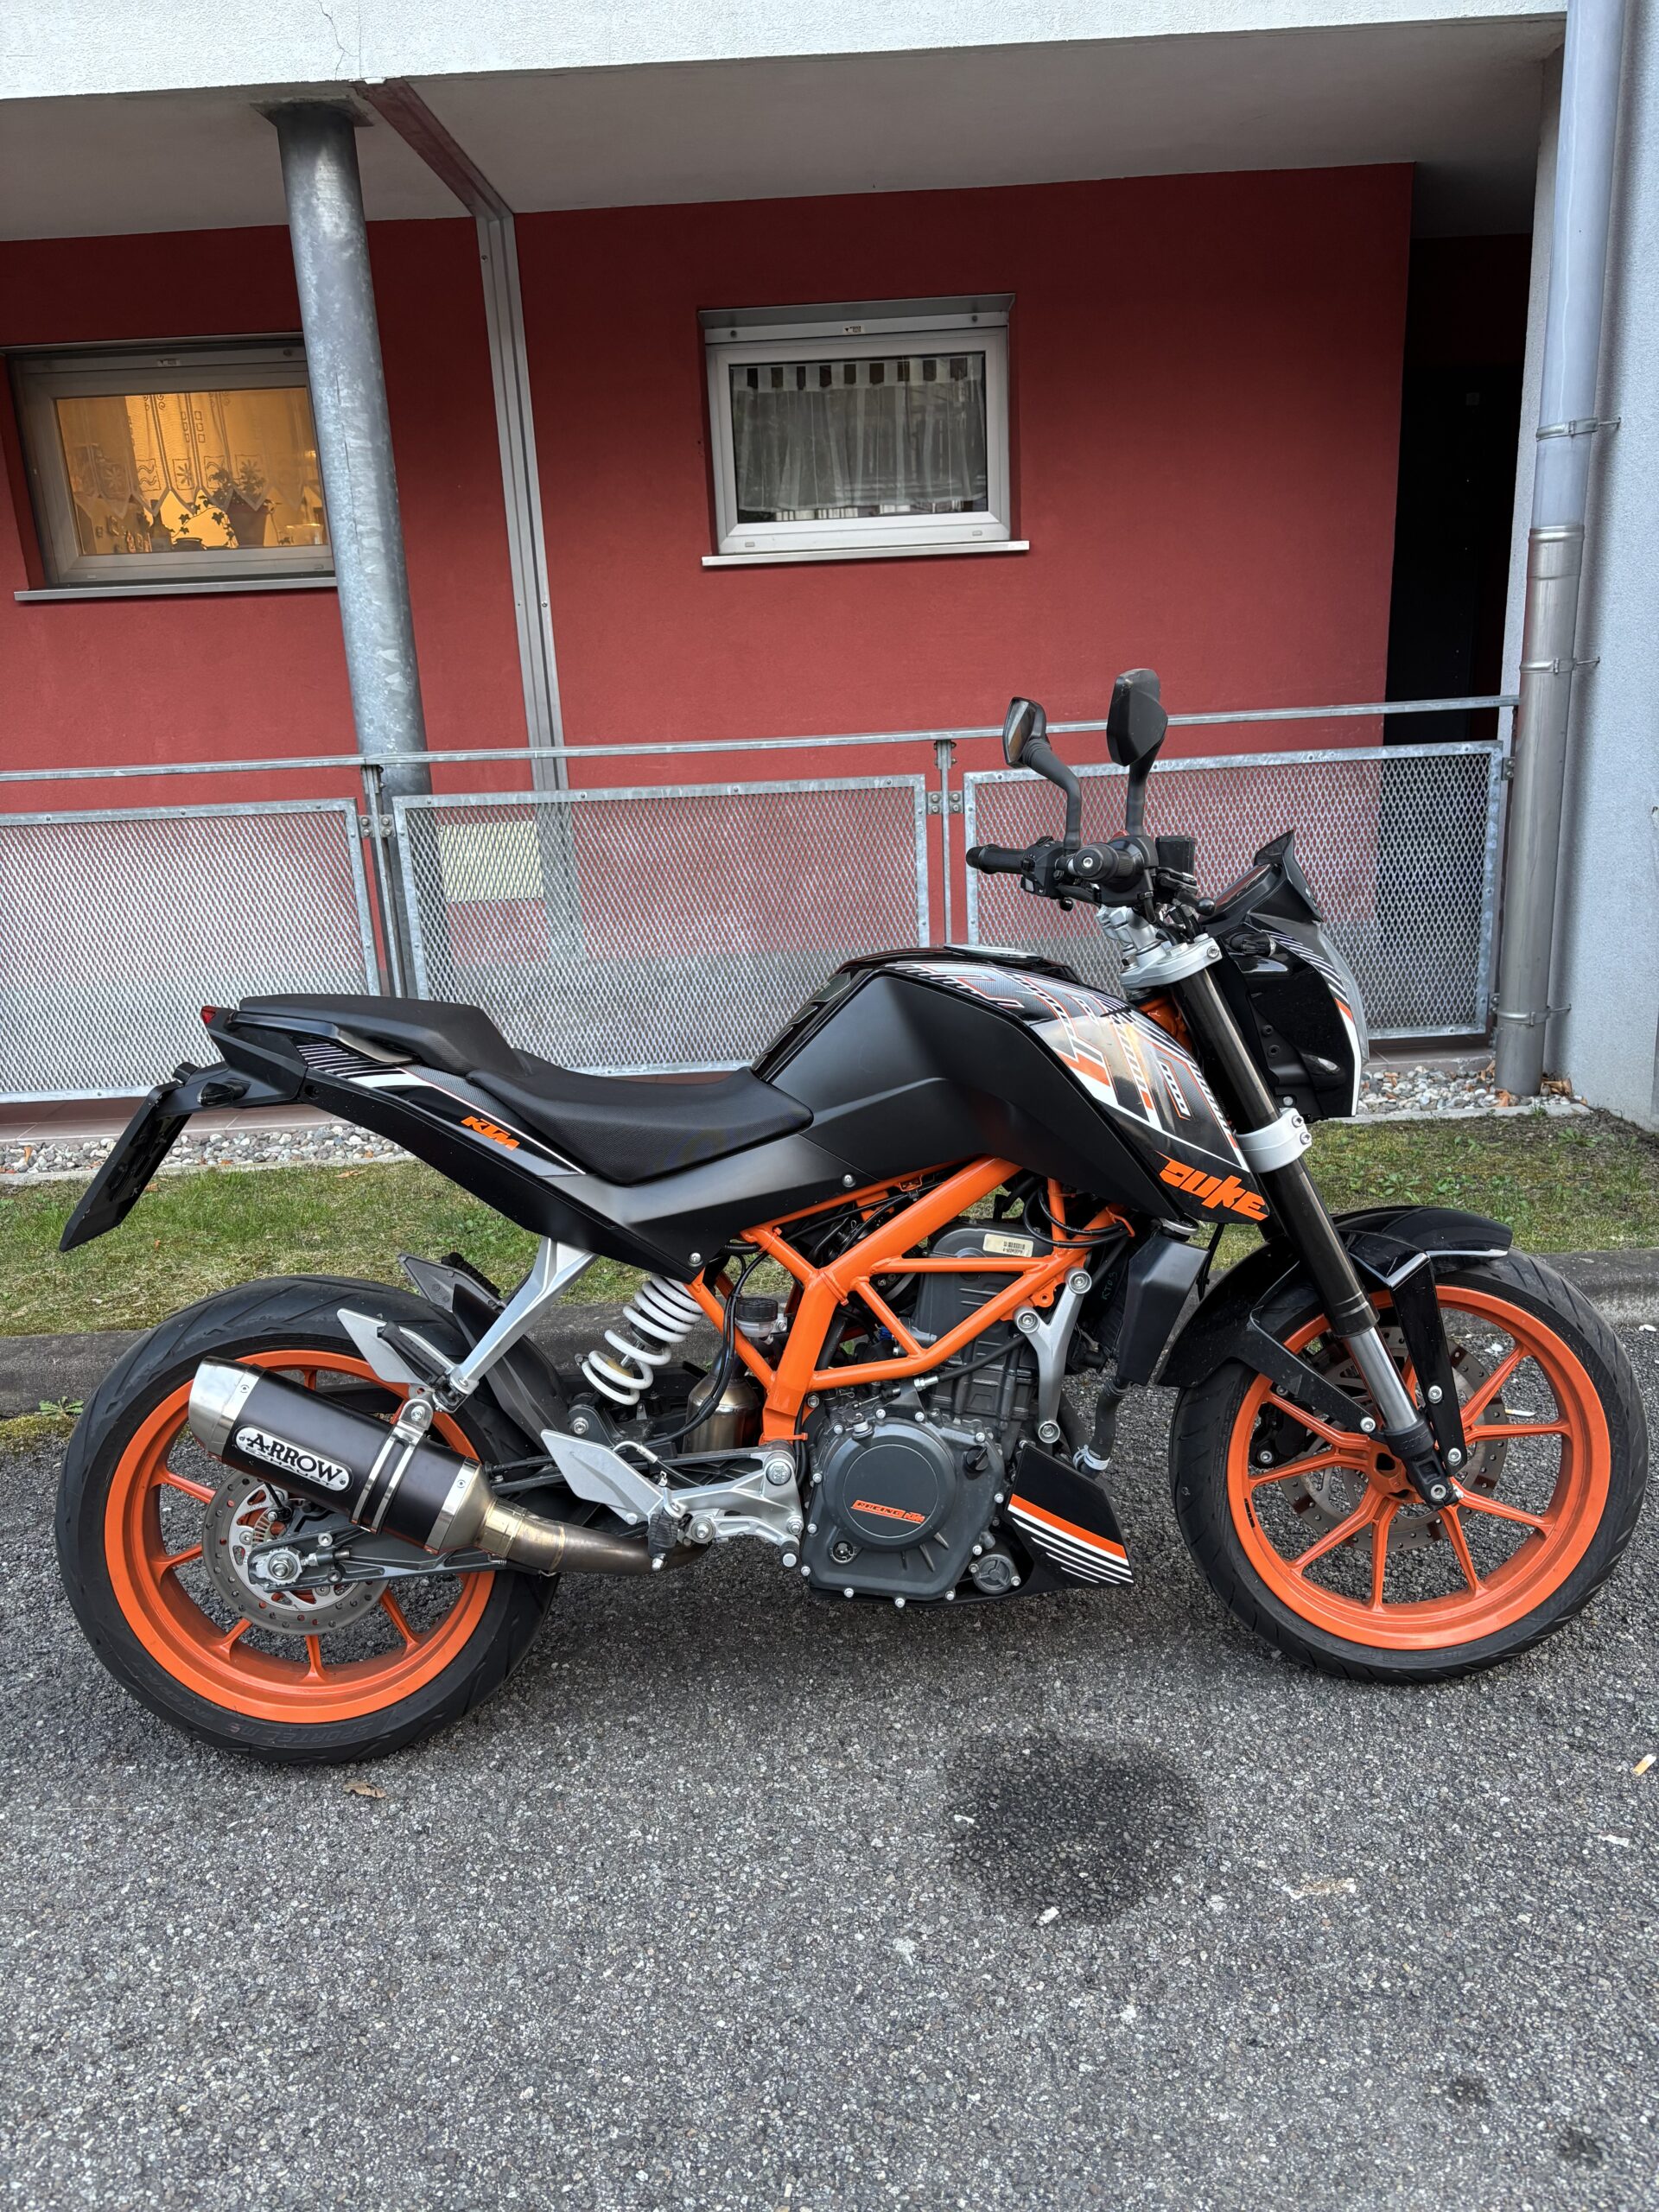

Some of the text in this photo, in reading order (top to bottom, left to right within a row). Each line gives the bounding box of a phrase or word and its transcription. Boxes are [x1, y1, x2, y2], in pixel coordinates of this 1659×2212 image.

[461, 1116, 520, 1151] KTM
[245, 1446, 334, 1486] EXHAUST
[246, 1433, 342, 1482] ARROW
[854, 1501, 925, 1522] RACING KTM
[262, 1722, 373, 1743] SPORTEC
